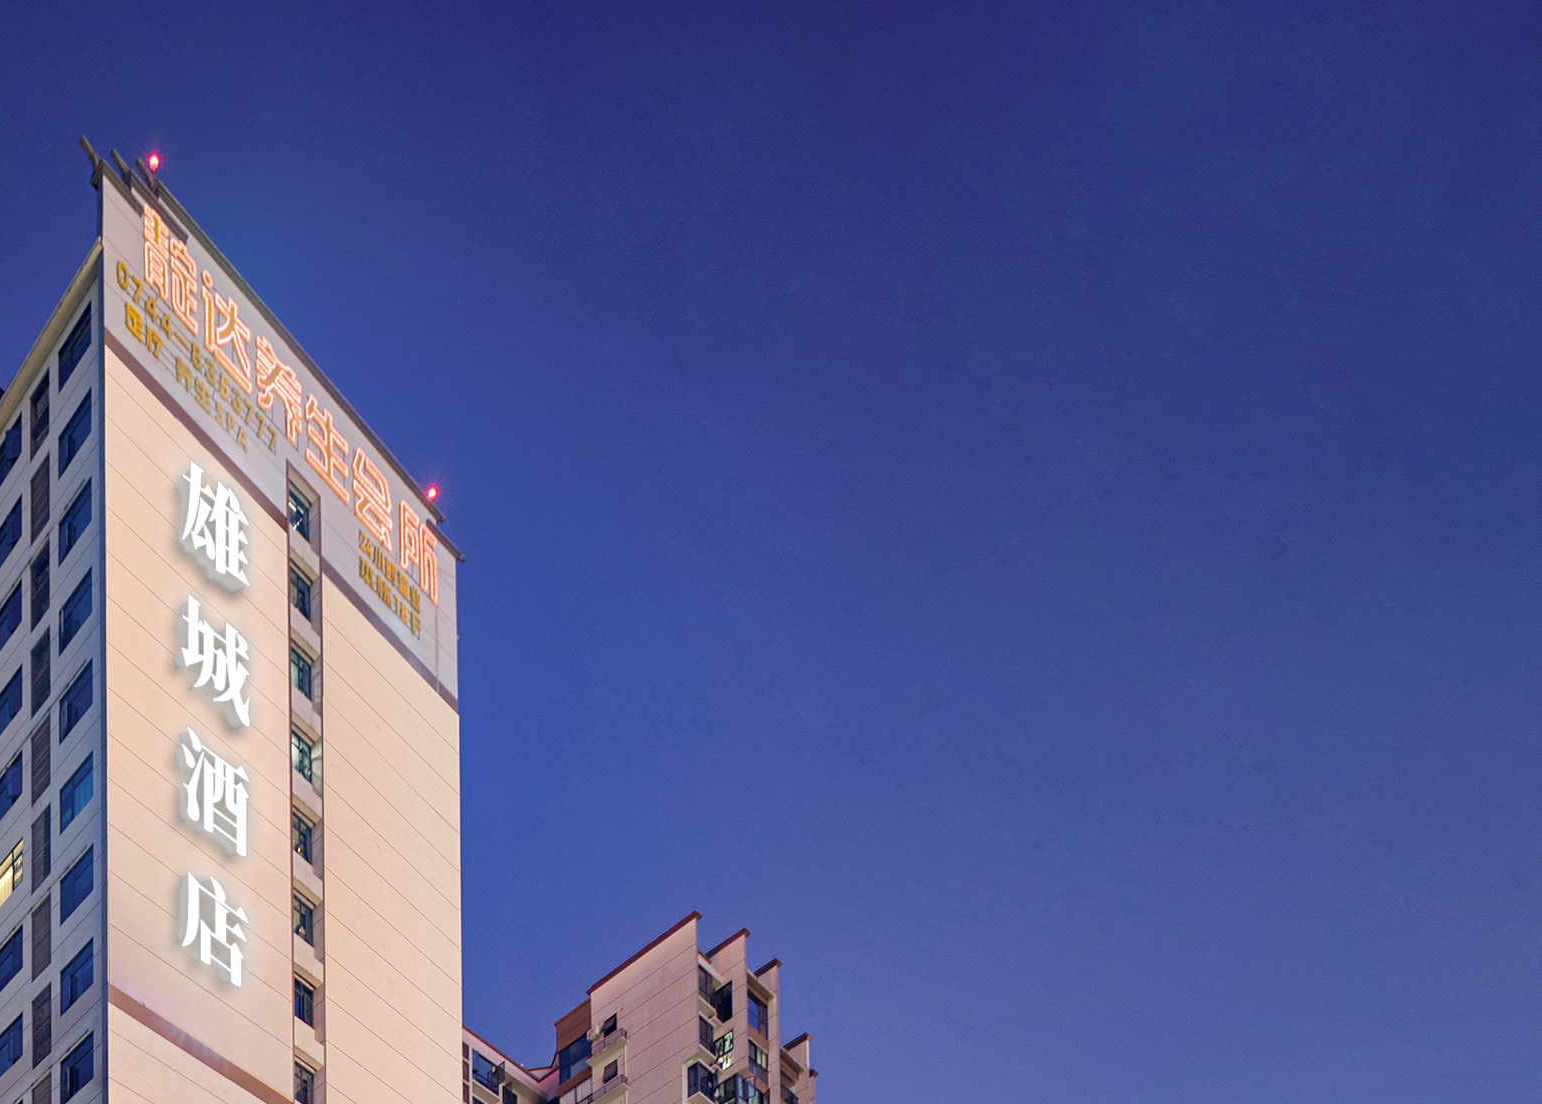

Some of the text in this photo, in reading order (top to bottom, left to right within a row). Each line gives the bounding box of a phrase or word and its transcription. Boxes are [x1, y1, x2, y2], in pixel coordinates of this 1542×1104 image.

[117, 261, 278, 451] 0744-8353777
[143, 204, 438, 605] 靛达养生会所
[180, 460, 251, 988] 雄城酒店
